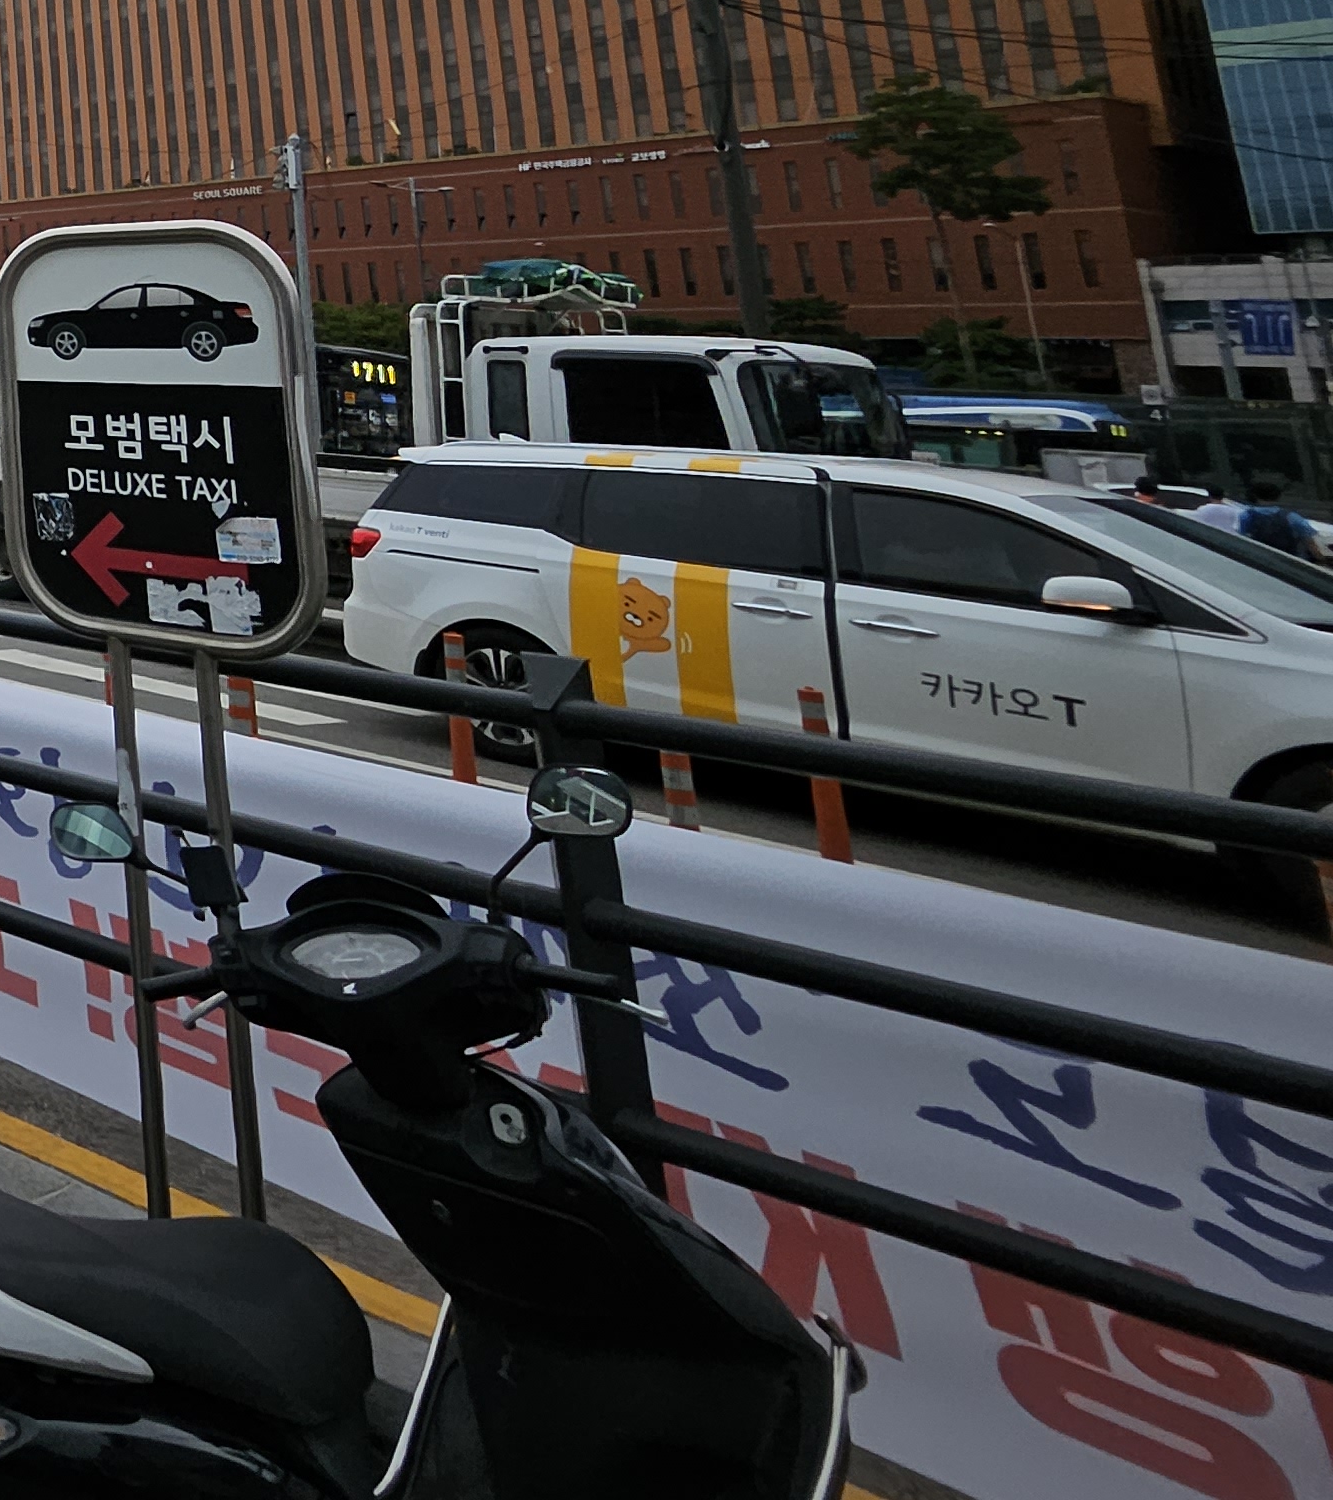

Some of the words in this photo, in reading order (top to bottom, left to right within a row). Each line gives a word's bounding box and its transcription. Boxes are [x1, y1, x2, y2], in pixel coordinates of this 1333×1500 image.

[193, 189, 221, 200] SEOUL
[223, 185, 263, 197] SQUARE
[64, 412, 235, 465] 모범택시
[67, 467, 167, 499] DELUXE
[175, 475, 238, 504] TAXI
[424, 529, 450, 539] venti
